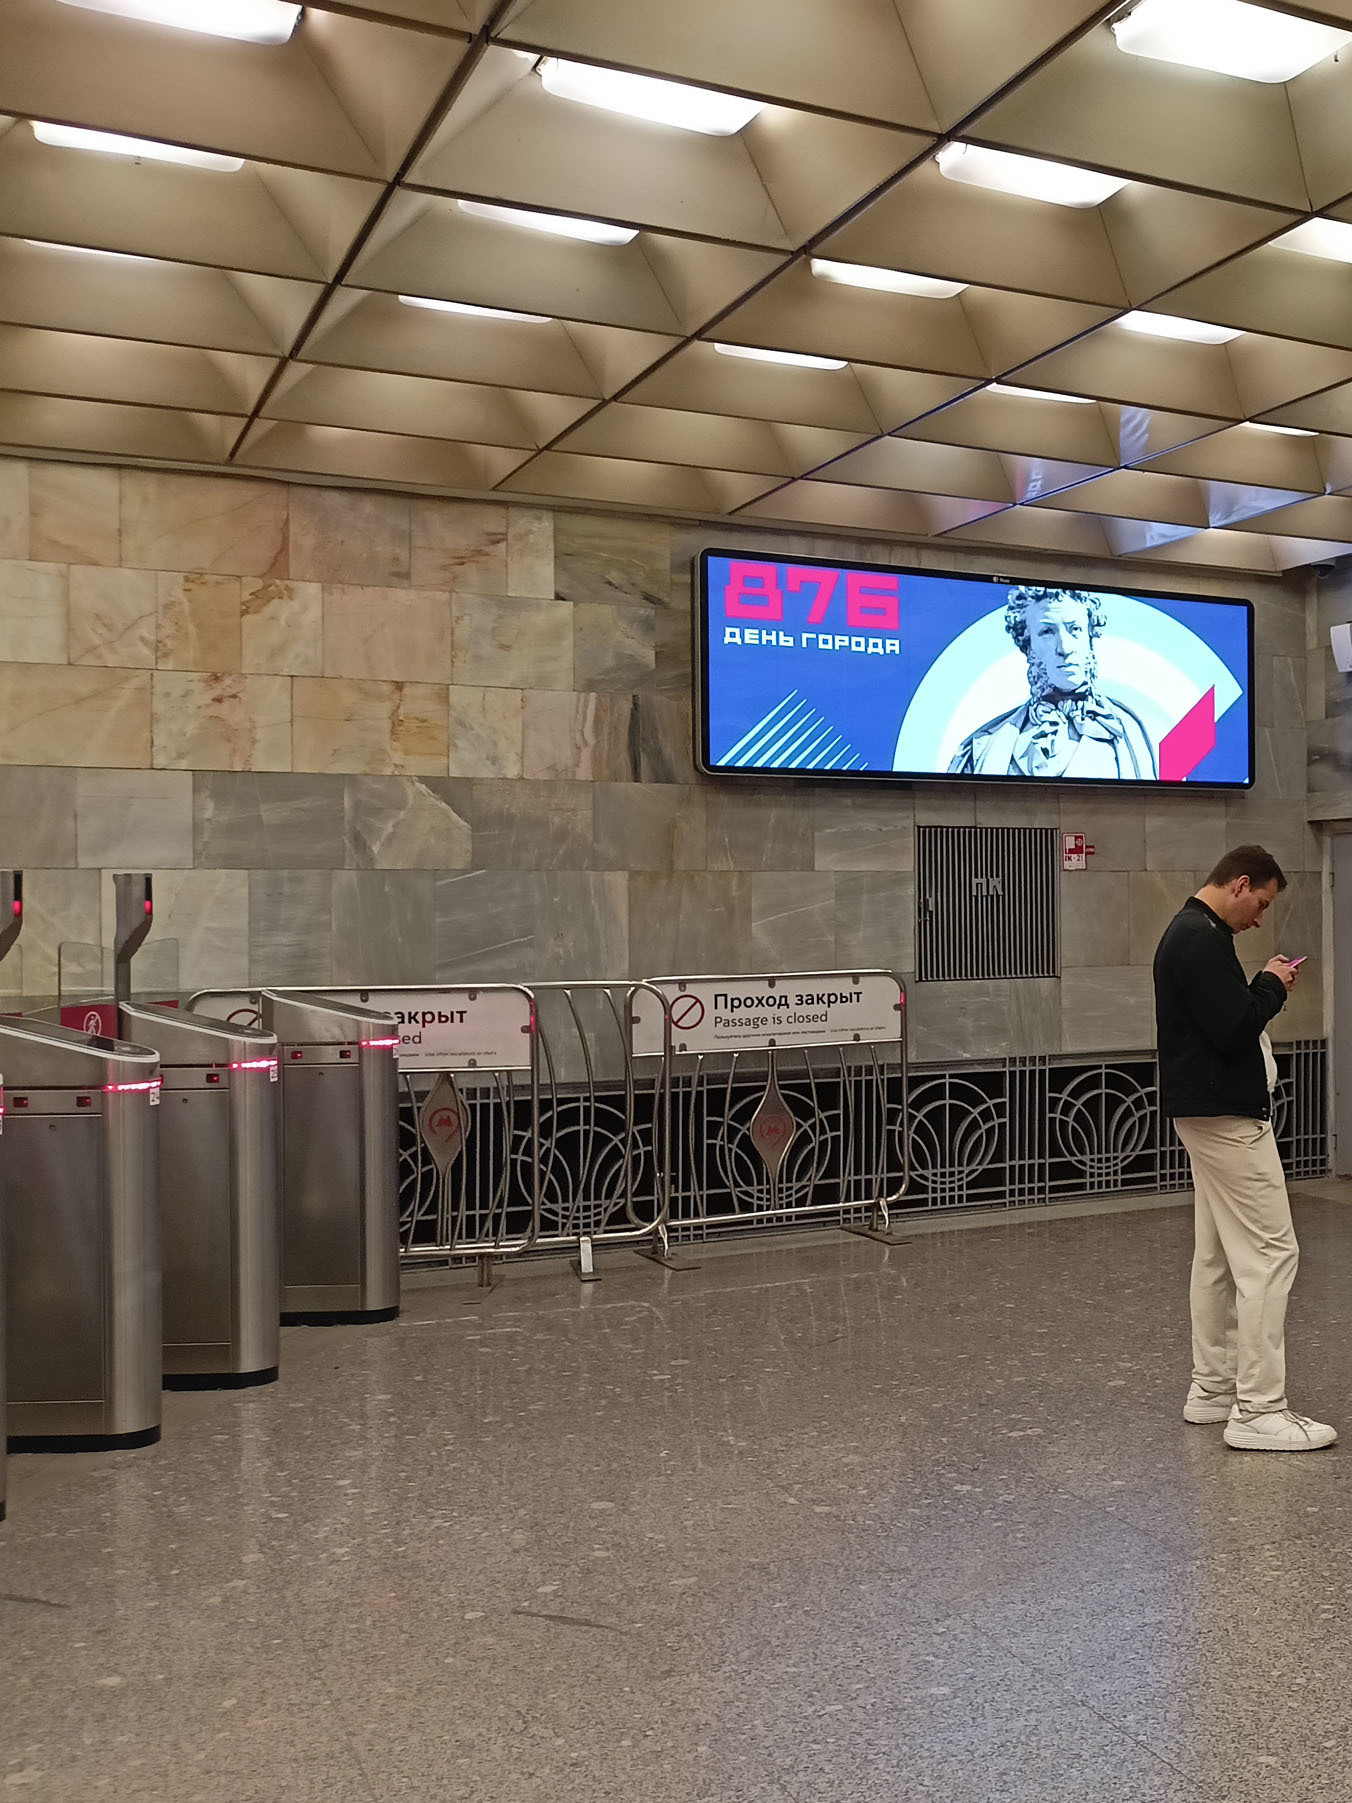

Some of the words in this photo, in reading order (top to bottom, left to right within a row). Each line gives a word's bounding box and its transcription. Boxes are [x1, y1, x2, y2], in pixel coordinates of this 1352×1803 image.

[724, 561, 899, 630] 876
[723, 626, 794, 647] ДЕНЬ
[801, 632, 900, 655] ГОРОДА
[971, 878, 1004, 896] ПК
[714, 994, 790, 1013] Проход
[794, 991, 863, 1008] закрыт
[384, 1009, 467, 1028] акрыт
[714, 1014, 768, 1029] Passage
[772, 1013, 783, 1024] is
[786, 1010, 828, 1024] closed
